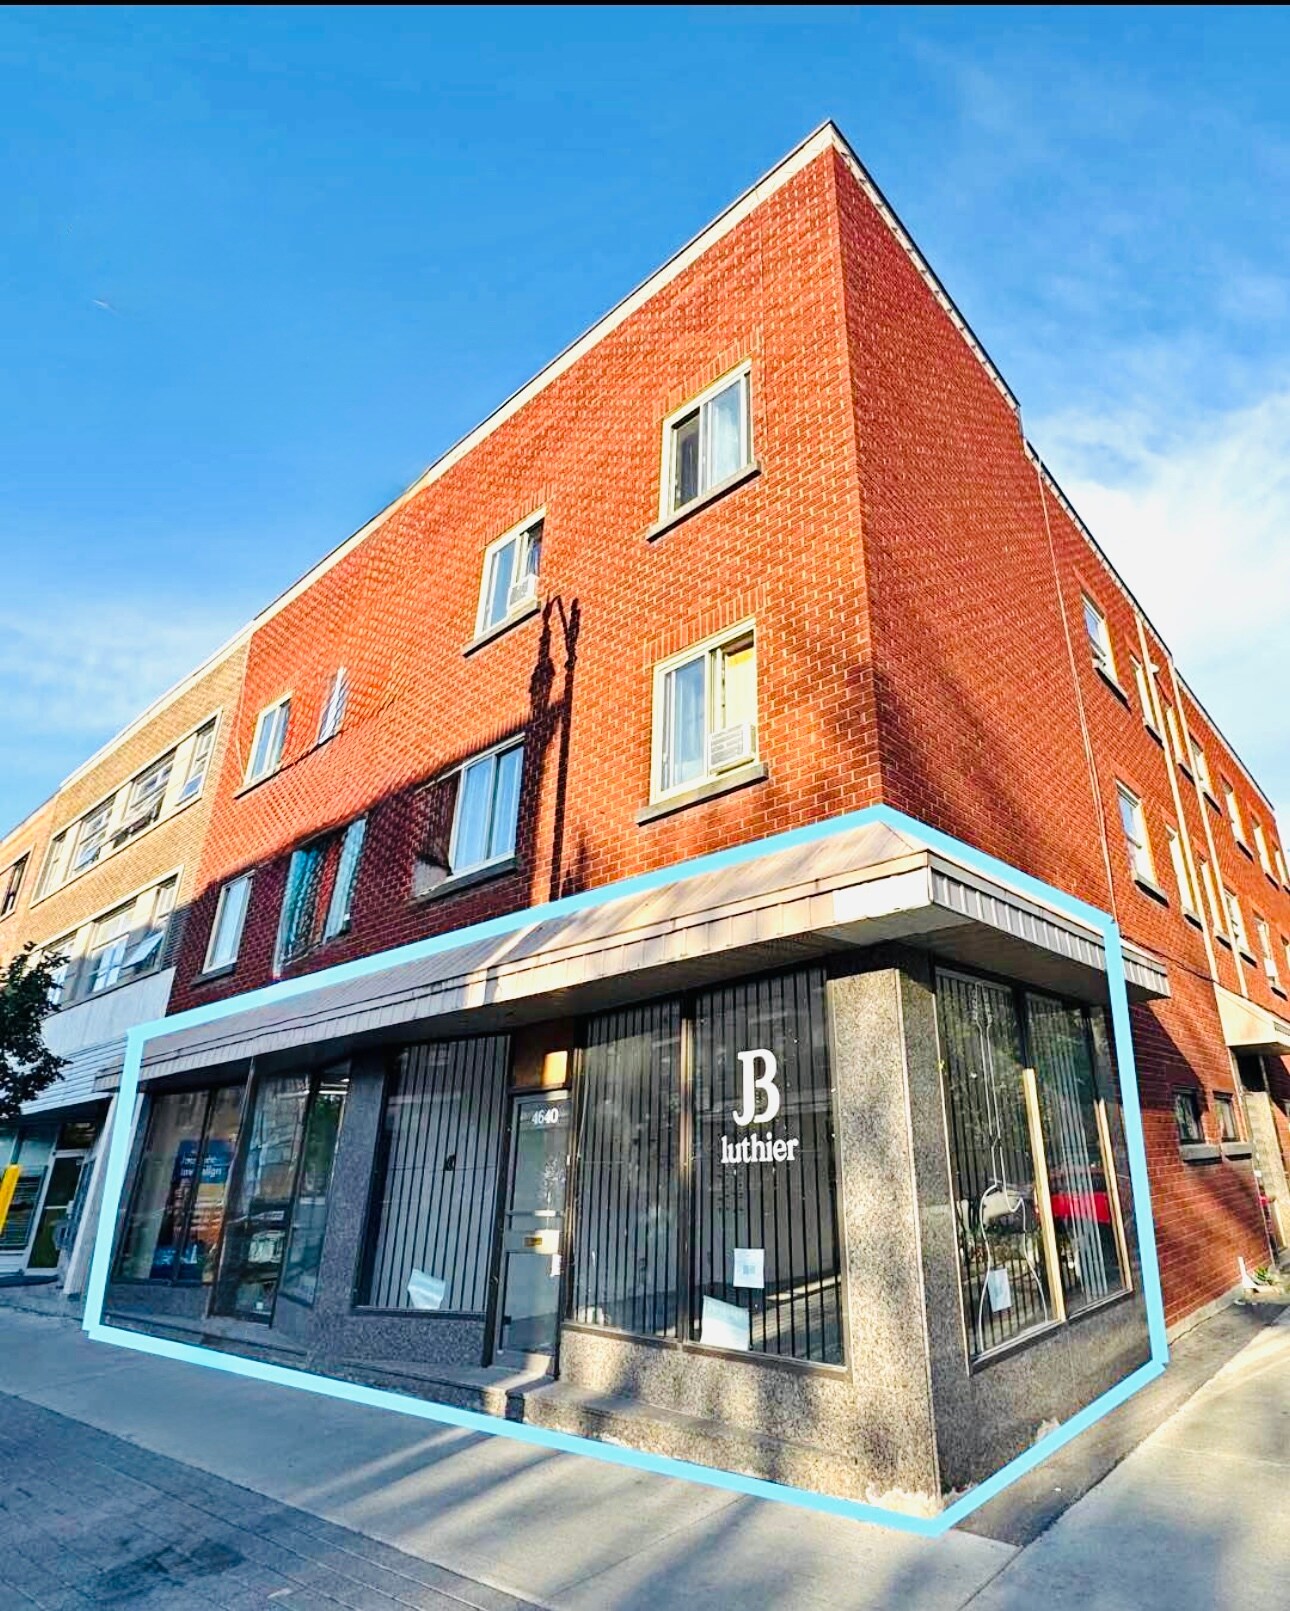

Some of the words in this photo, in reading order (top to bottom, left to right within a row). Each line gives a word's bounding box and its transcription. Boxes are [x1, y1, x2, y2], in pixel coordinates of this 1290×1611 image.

[732, 1048, 781, 1127] JB
[532, 1107, 559, 1125] 4640
[720, 1131, 799, 1164] luthier
